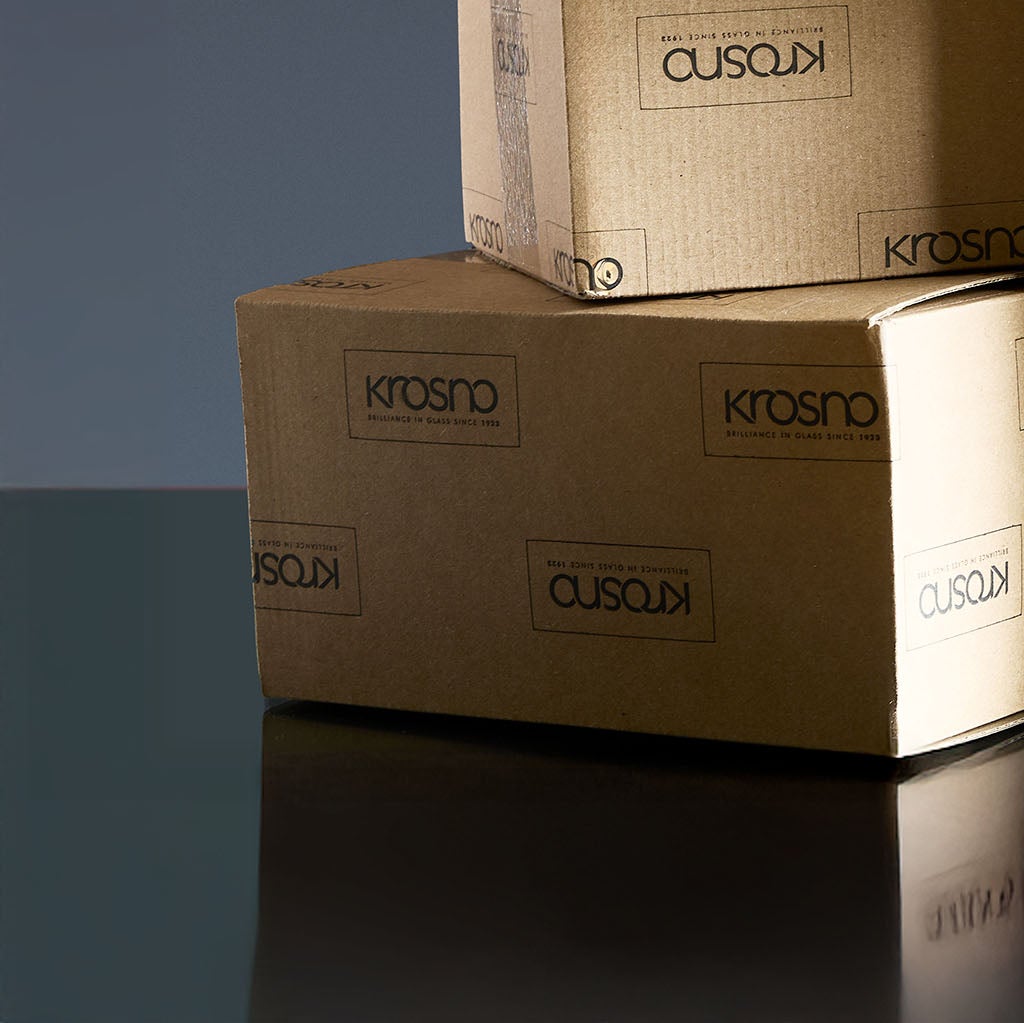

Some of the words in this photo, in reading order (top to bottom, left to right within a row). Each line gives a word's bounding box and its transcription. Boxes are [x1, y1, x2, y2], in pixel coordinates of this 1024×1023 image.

[689, 32, 716, 41] SINCE
[722, 30, 750, 39] GLASS
[755, 29, 766, 37] IN
[414, 416, 423, 424] IN
[427, 417, 450, 425] GLASS
[454, 418, 477, 426] SINCE
[726, 430, 776, 439] BRILLIANCE
[795, 432, 822, 440] GLASS
[826, 433, 854, 441] SINCE
[627, 565, 637, 573] IN
